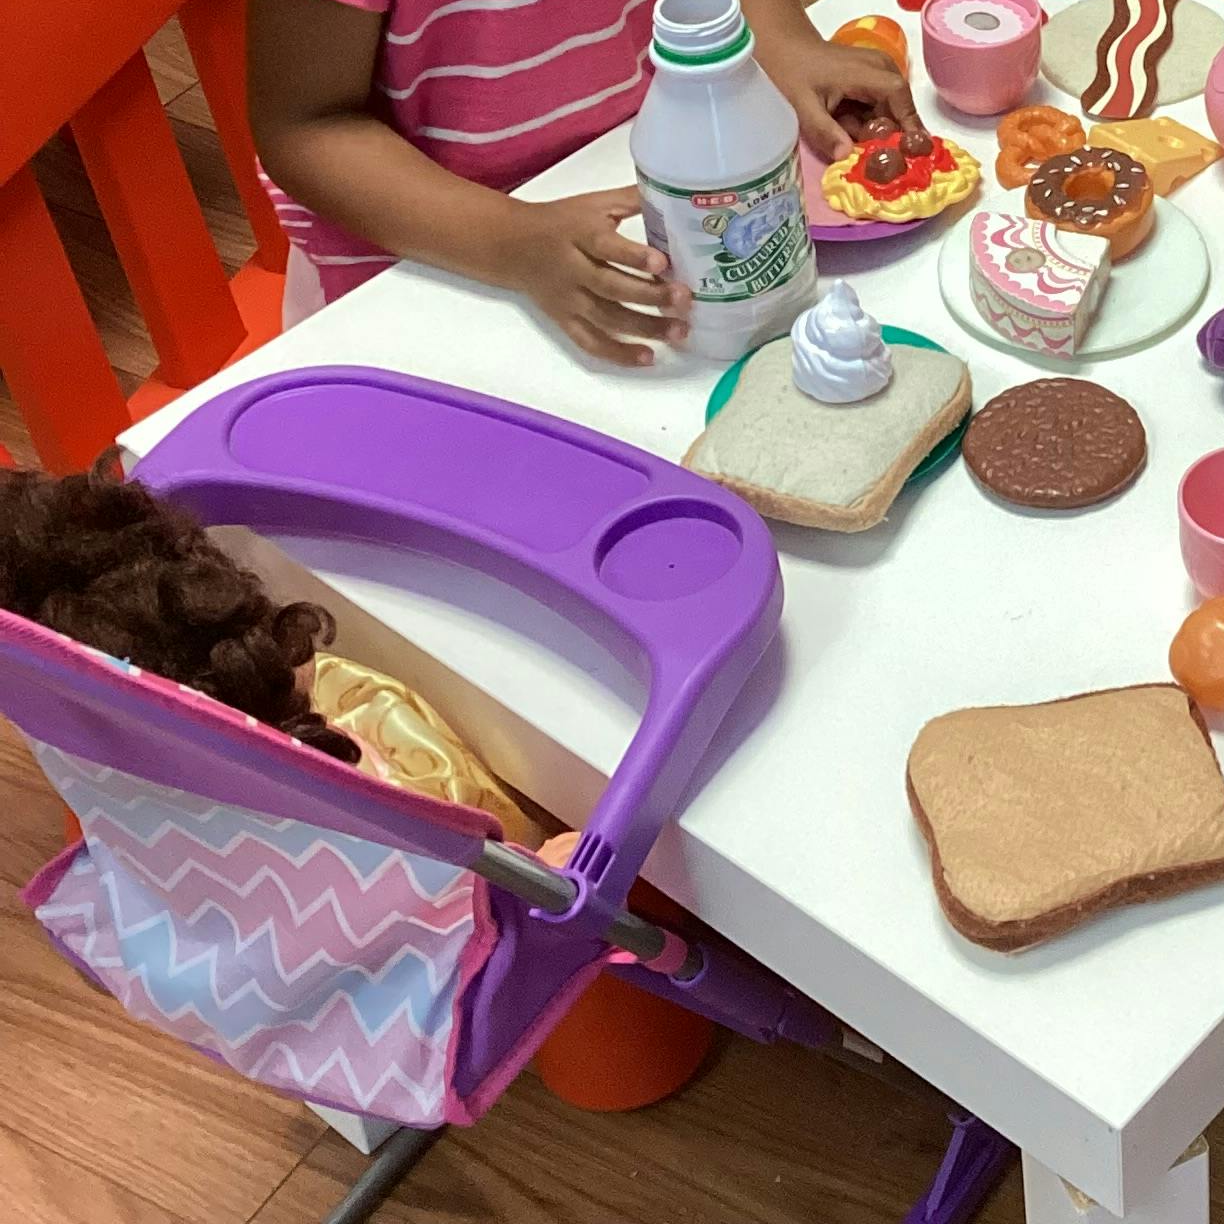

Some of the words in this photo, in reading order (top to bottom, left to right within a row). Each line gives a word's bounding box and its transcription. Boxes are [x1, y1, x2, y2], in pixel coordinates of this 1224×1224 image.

[747, 191, 770, 208] LOW
[772, 184, 786, 195] FAT
[726, 226, 789, 280] CULTURED
[750, 225, 803, 292] BUTTERMI
